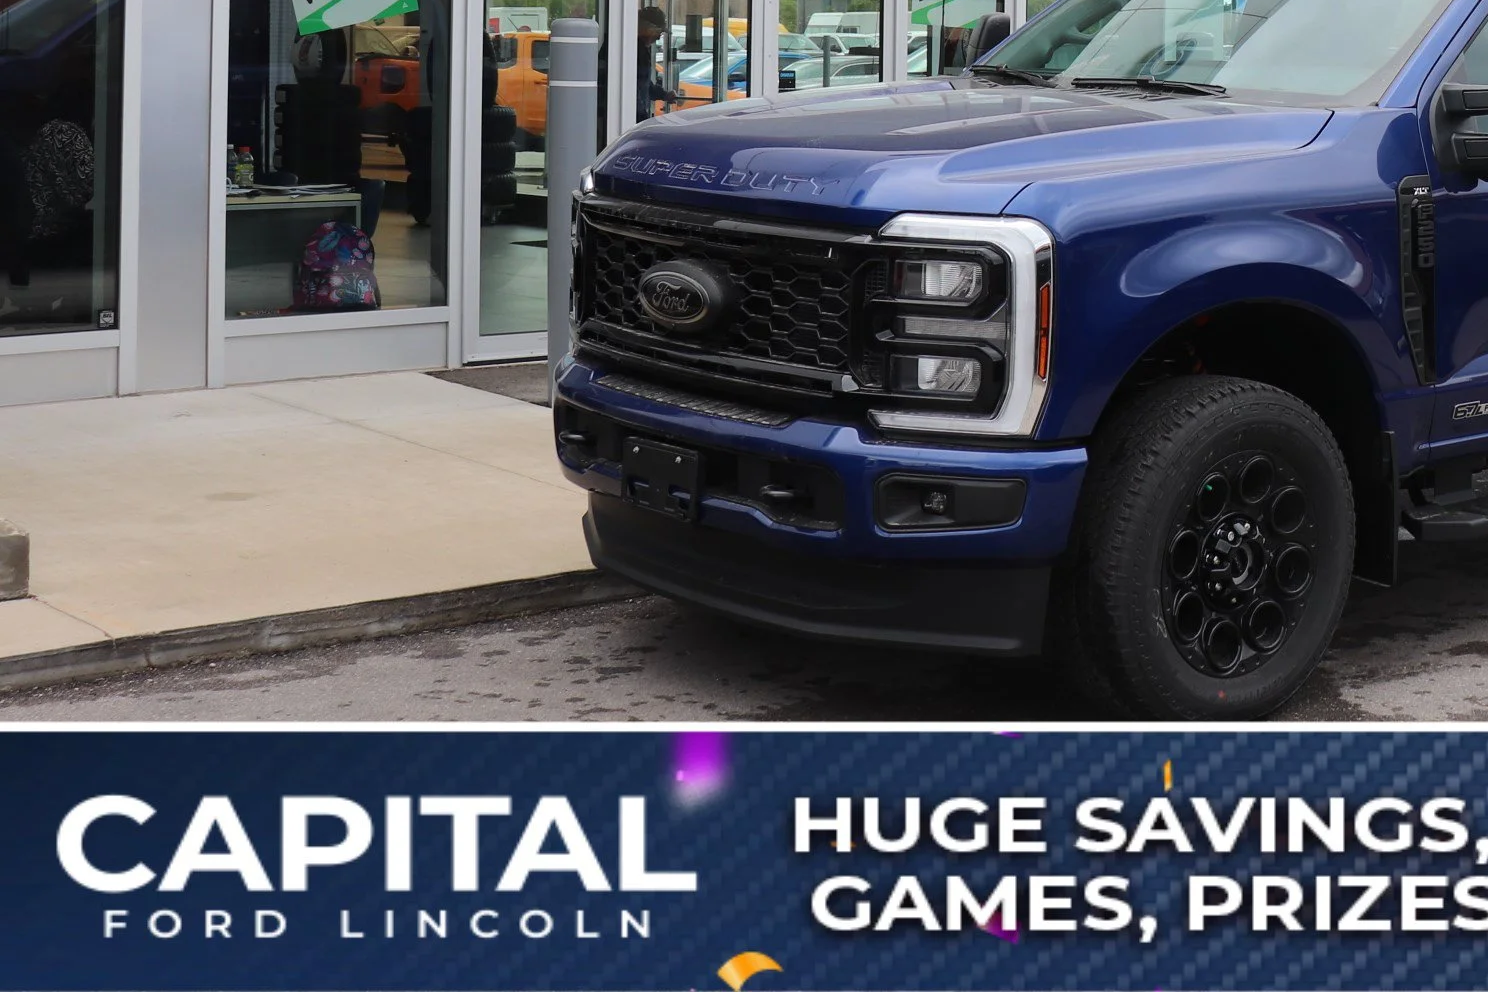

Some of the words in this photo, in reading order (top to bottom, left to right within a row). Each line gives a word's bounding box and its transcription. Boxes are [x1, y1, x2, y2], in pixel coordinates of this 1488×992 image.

[614, 156, 719, 184] SUPER
[720, 169, 841, 196] DUTY
[1413, 187, 1430, 196] XLT
[652, 280, 691, 312] Ford
[1453, 401, 1483, 420] 6.7L
